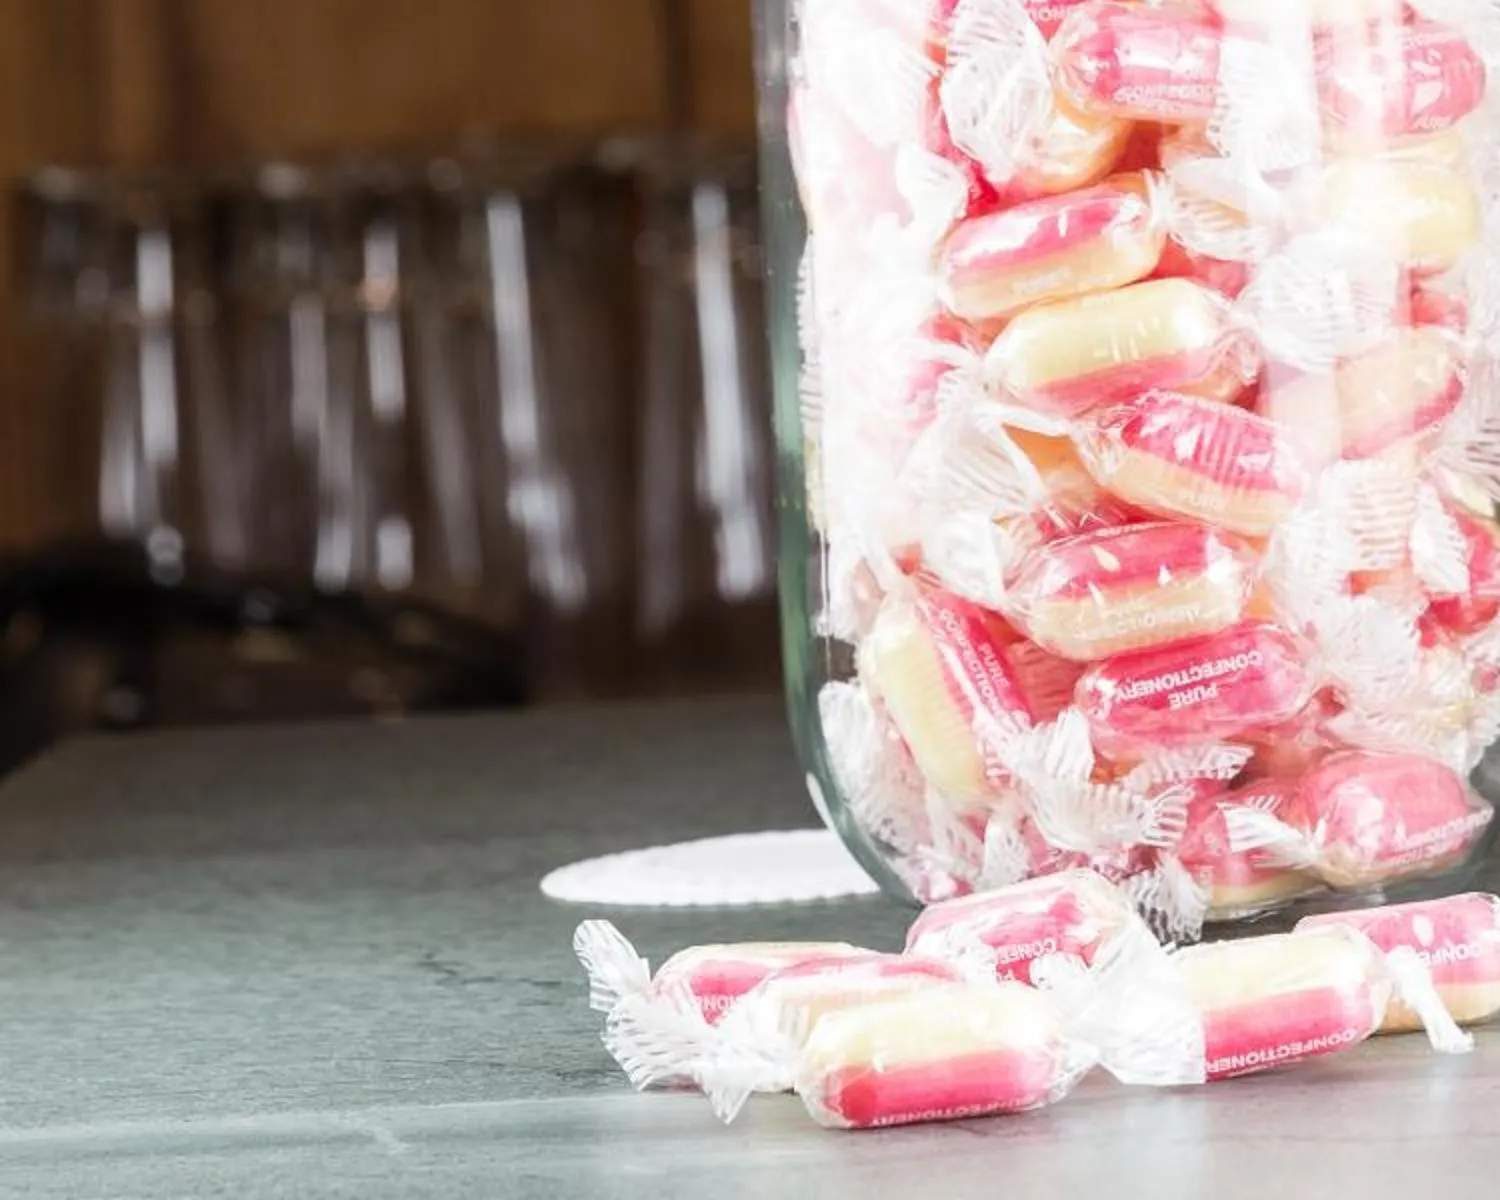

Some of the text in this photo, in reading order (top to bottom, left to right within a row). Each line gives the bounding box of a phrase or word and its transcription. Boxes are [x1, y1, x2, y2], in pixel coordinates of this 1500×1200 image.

[977, 642, 1011, 689] PURE
[1114, 649, 1265, 703] CONFECTIONERY
[1167, 683, 1218, 711] PURE
[1204, 1027, 1357, 1073] CONFECTIONER
